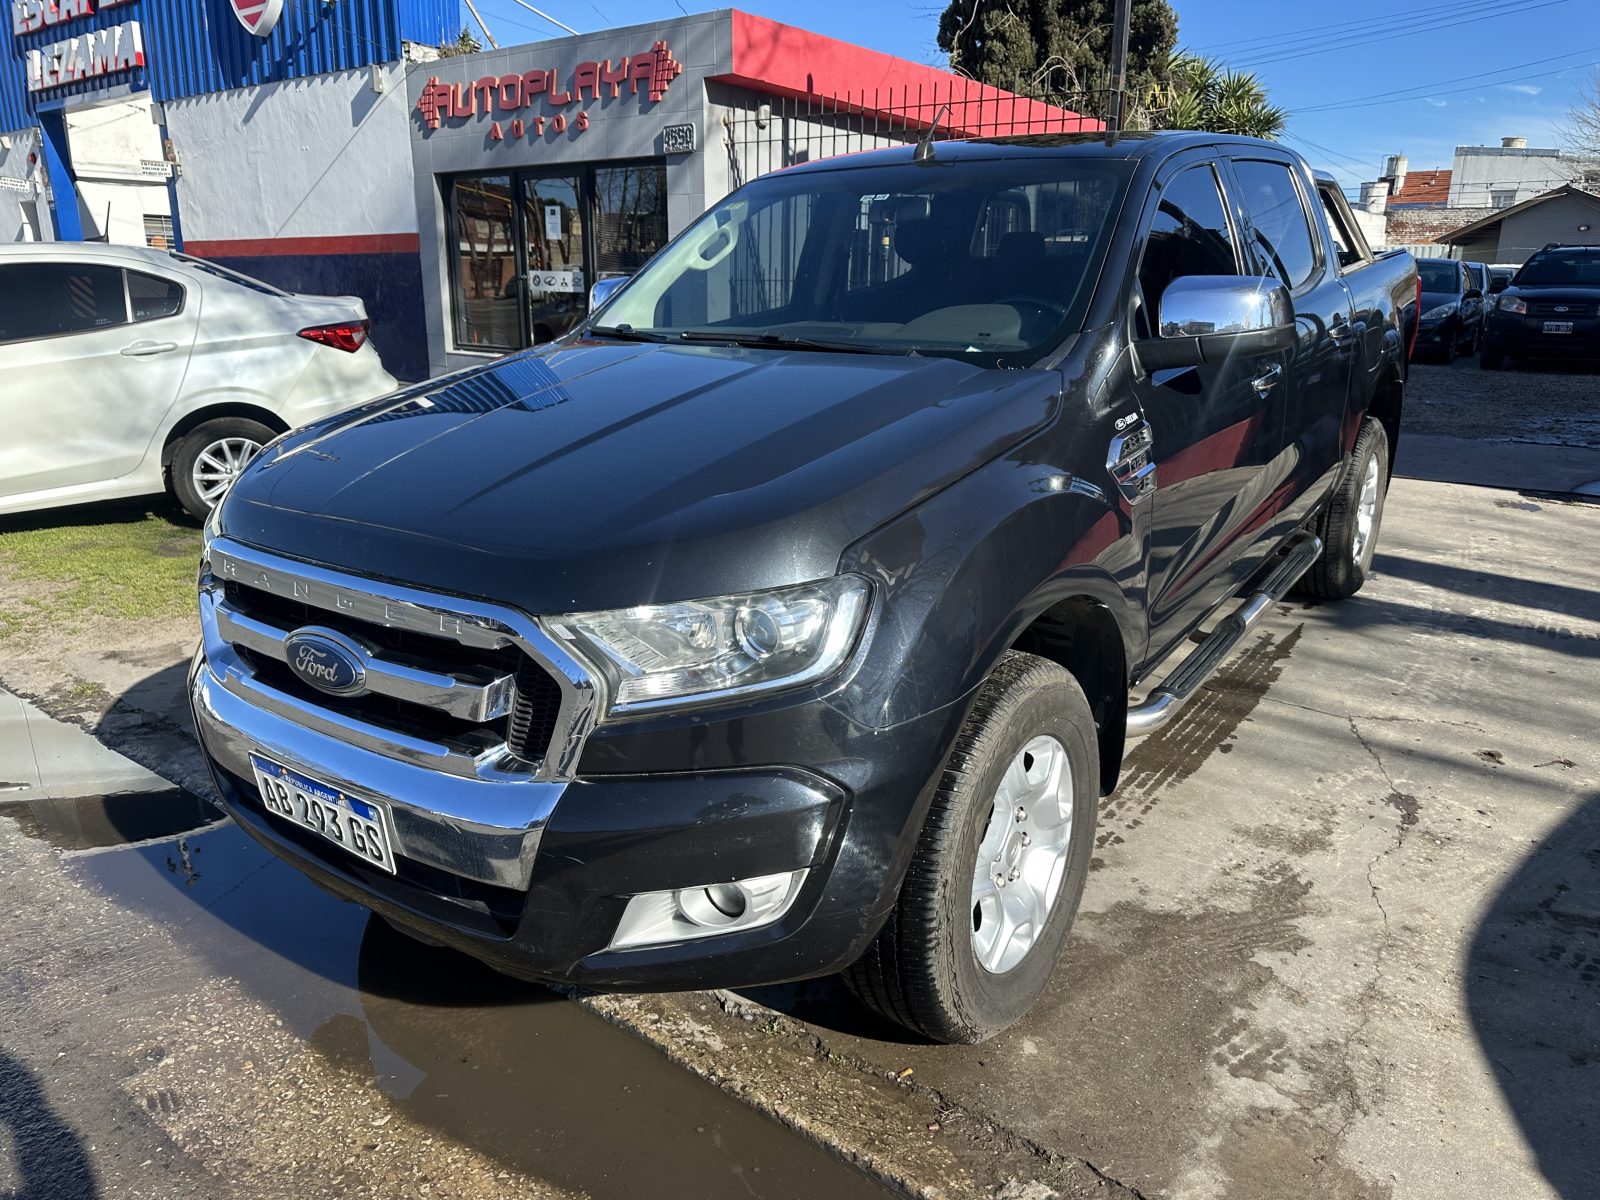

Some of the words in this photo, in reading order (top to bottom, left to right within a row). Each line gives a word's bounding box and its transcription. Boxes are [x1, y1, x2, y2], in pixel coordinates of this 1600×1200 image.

[26, 20, 145, 91] LEZAMA
[432, 52, 657, 118] AUTOPLAYA
[489, 111, 589, 140] AUTOS
[223, 558, 464, 636] RANGER
[295, 645, 338, 683] Ford
[263, 776, 295, 815] AB
[296, 791, 345, 842] 293
[349, 816, 385, 862] GS
